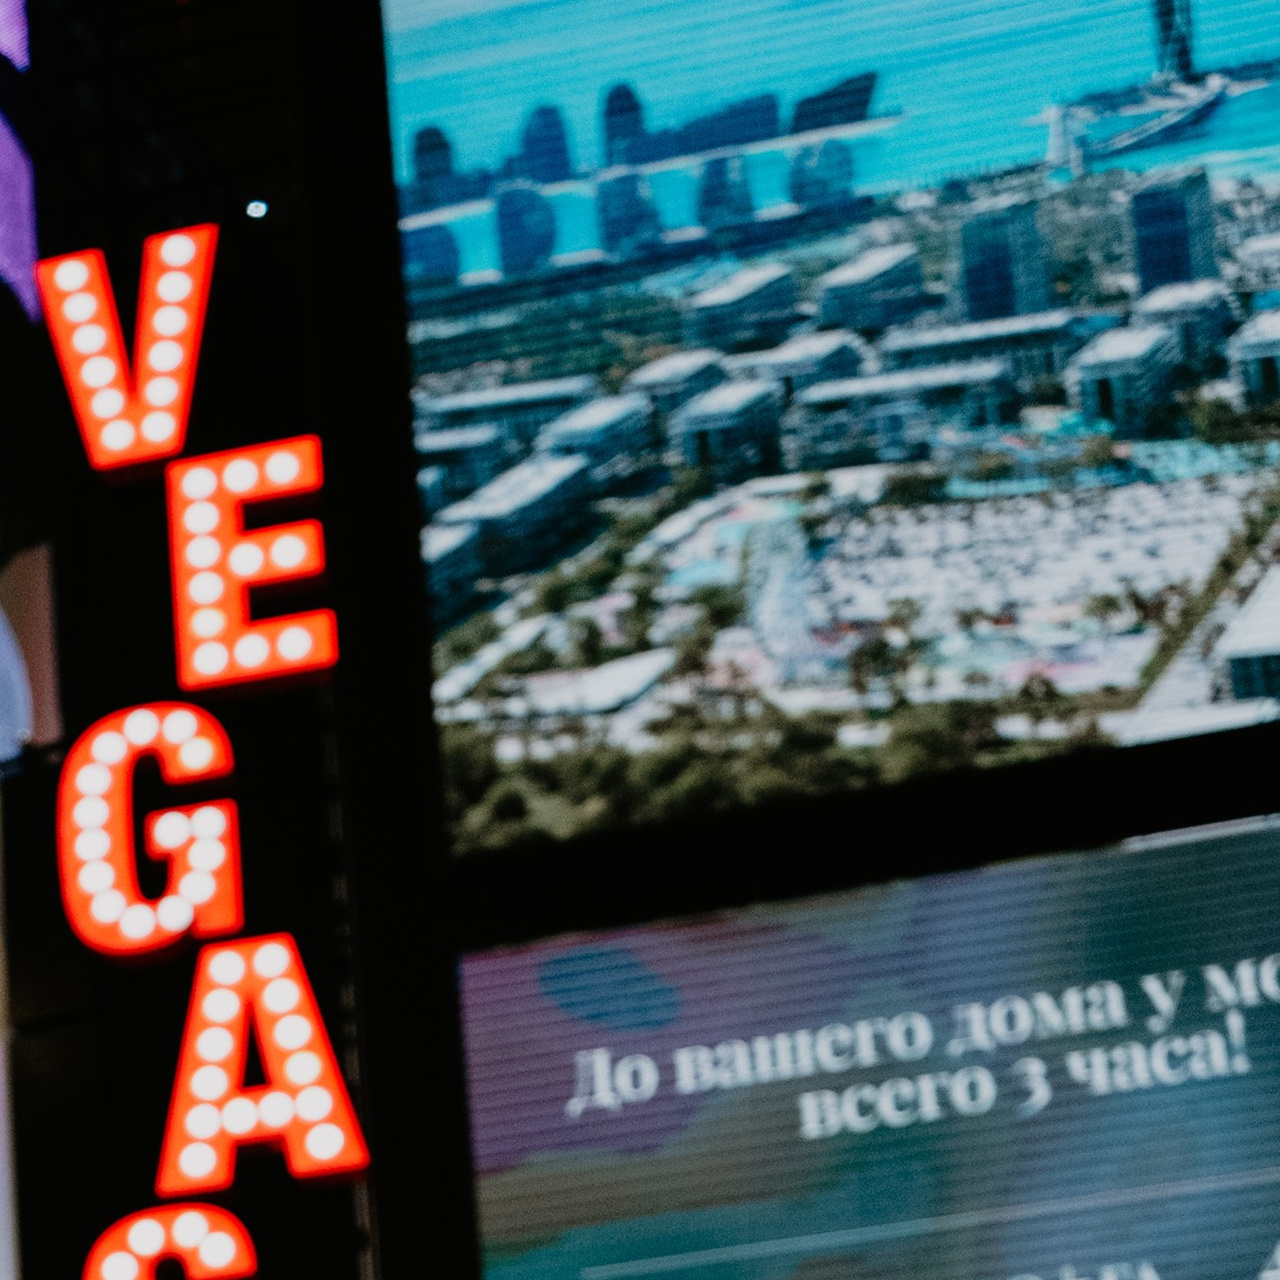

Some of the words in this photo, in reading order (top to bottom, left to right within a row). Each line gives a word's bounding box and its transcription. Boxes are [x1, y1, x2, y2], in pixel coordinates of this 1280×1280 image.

[564, 1047, 660, 1122] До
[674, 1011, 934, 1096] вашего
[945, 979, 1132, 1058] дома
[1138, 969, 1187, 1035] у
[798, 1066, 998, 1141] всего
[1009, 1056, 1053, 1119] 3
[1066, 1008, 1252, 1096] часа!
